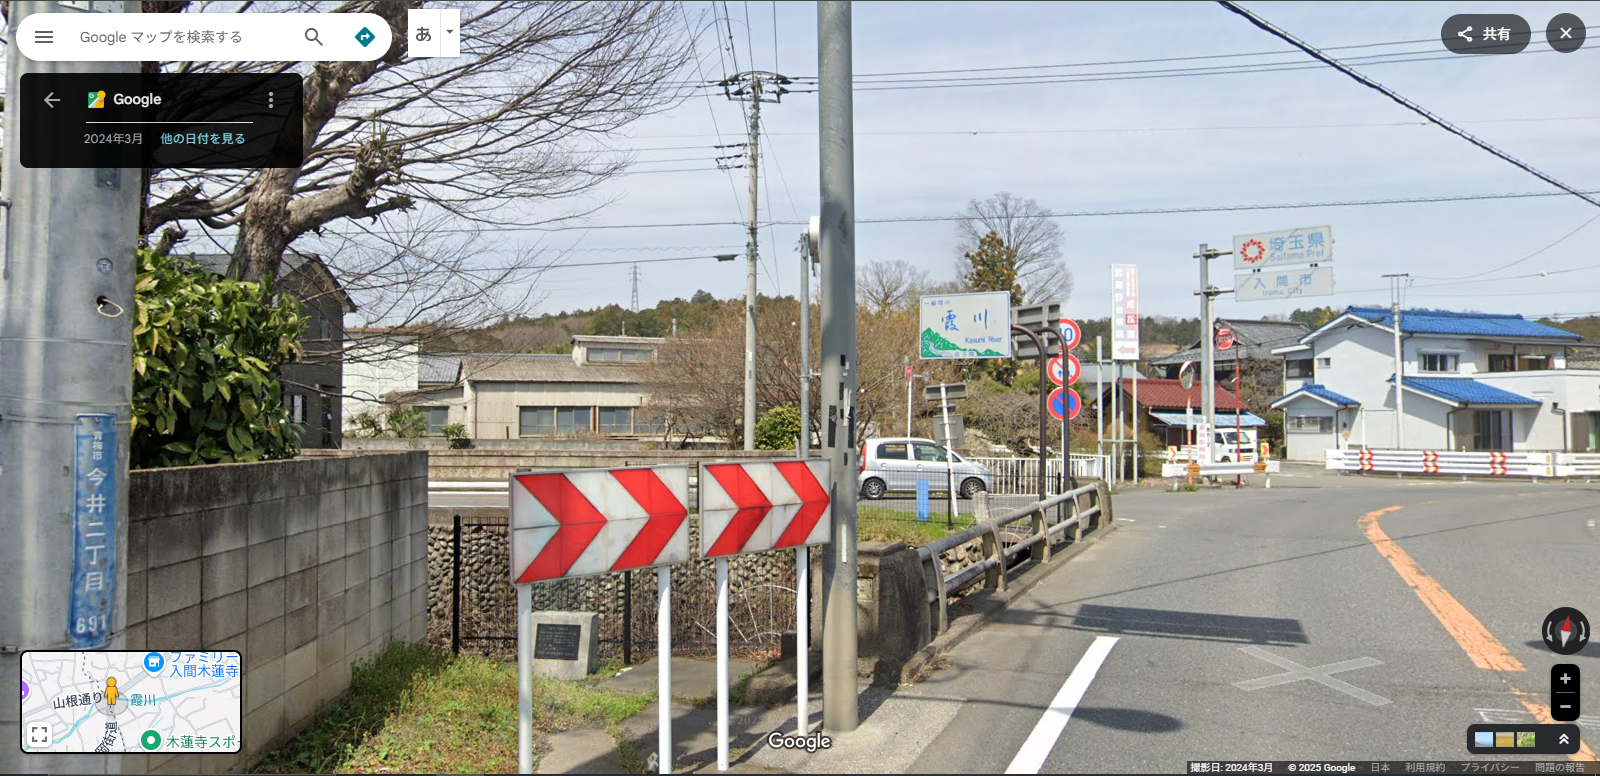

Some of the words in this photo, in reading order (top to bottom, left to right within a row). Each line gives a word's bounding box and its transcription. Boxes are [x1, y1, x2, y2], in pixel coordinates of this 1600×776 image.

[1270, 232, 1325, 251] 埼玉県
[1270, 251, 1304, 261] Saitama
[1253, 273, 1312, 289] 入間市
[1288, 286, 1303, 295] City
[988, 336, 1003, 344] River
[92, 430, 103, 460] 青梅市
[85, 467, 107, 592] 今井二丁目
[76, 614, 107, 634] 691
